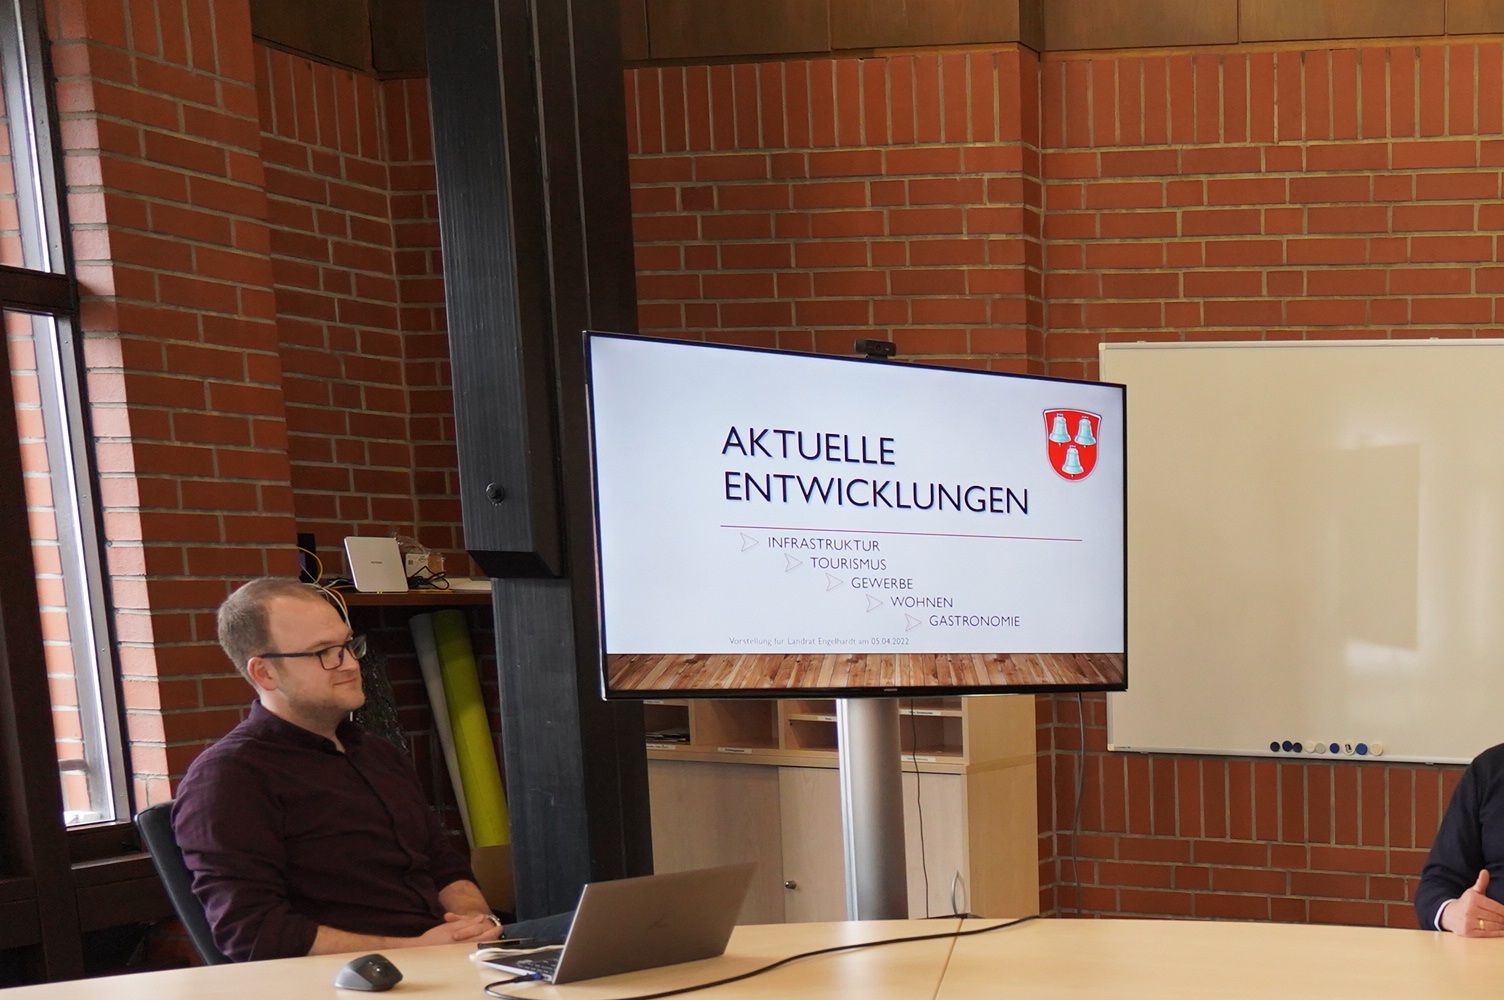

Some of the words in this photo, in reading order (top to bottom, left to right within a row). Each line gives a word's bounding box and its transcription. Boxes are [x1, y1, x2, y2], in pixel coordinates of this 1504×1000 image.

[721, 425, 896, 466] AKTUELLE
[724, 470, 1029, 515] ENTWICKLUNGEN
[767, 536, 880, 552] INFRASTRUKTUR
[810, 556, 887, 571] TOURISMUS
[851, 576, 914, 590] GEWERBE
[890, 596, 953, 609] WOHNEN
[929, 614, 1021, 627] GASTRONOMIE
[728, 637, 772, 647] Vorstellung
[787, 637, 815, 646] Landrat
[858, 638, 870, 646] am
[870, 637, 910, 646] 05.04.2022
